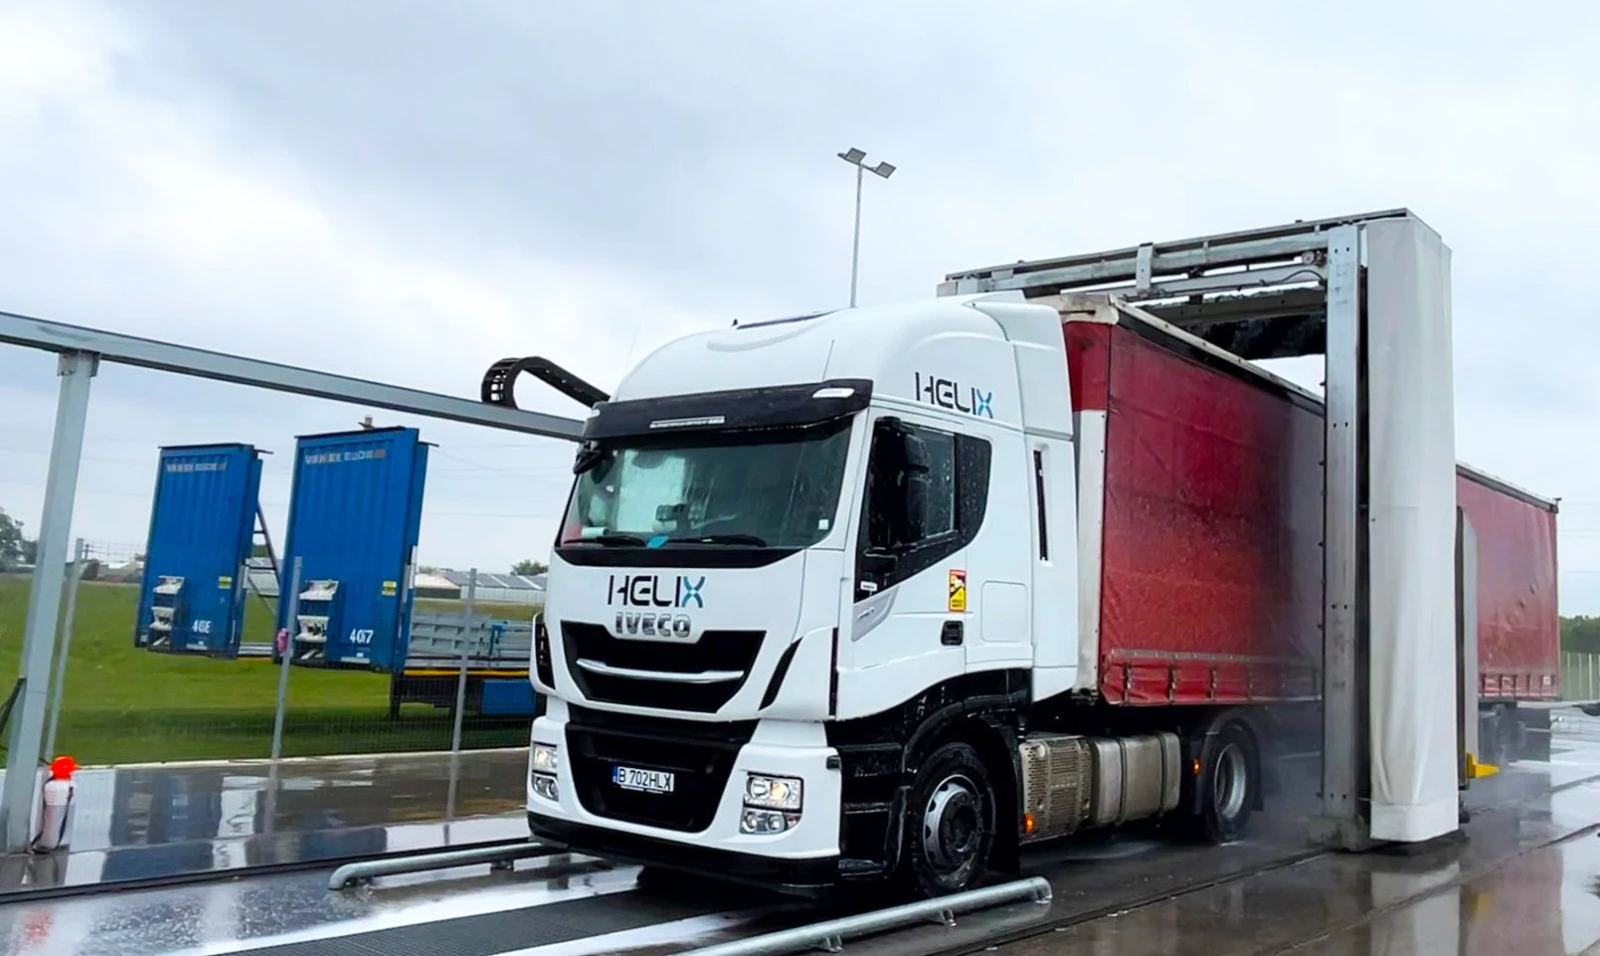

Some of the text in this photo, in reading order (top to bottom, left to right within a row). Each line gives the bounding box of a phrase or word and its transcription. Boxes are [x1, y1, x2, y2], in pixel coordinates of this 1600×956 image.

[915, 371, 993, 419] HELIX
[607, 575, 705, 608] HELIX
[615, 612, 691, 638] IVECO
[619, 768, 626, 783] B
